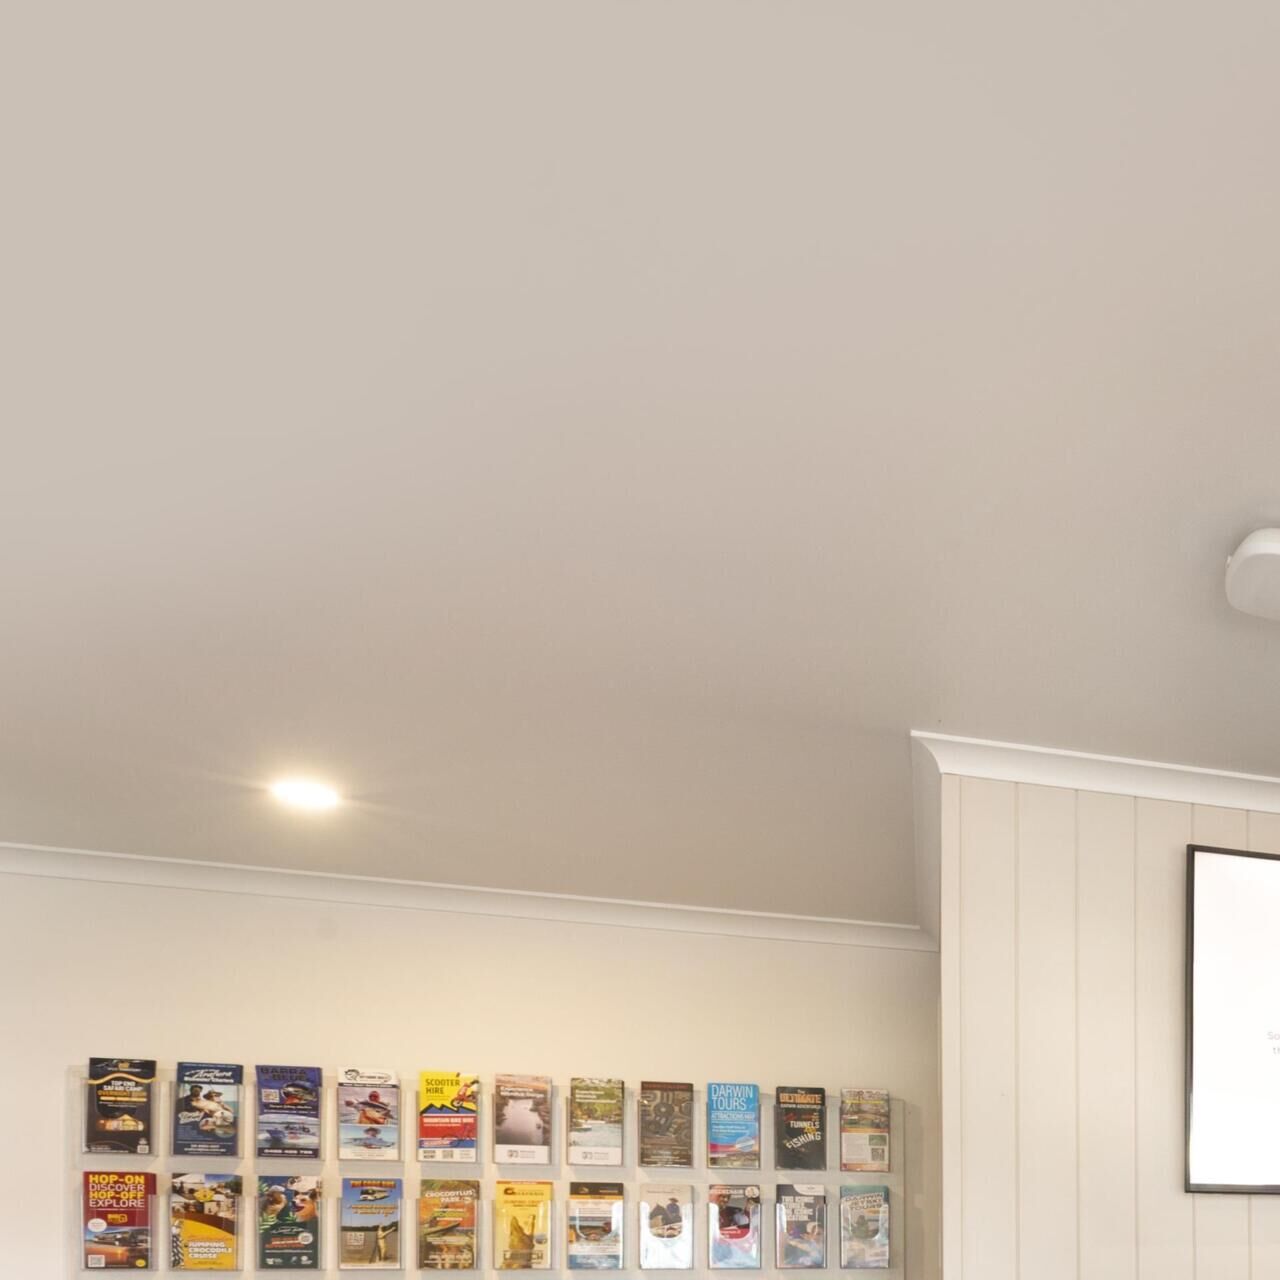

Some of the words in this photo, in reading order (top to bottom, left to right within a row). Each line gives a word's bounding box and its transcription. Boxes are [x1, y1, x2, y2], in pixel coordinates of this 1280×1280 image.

[425, 1078, 460, 1087] SCOOTER
[711, 1085, 753, 1099] DARWIN
[779, 1093, 822, 1104] ULTIMATE
[711, 1098, 747, 1111] TOURS
[790, 1120, 820, 1128] TUNNELS
[785, 1131, 822, 1149] FISHING
[89, 1174, 145, 1184] HOP-ON
[89, 1183, 145, 1192] DISCOVER
[89, 1191, 145, 1200] HOP-OFF
[89, 1199, 145, 1208] EXPLORE
